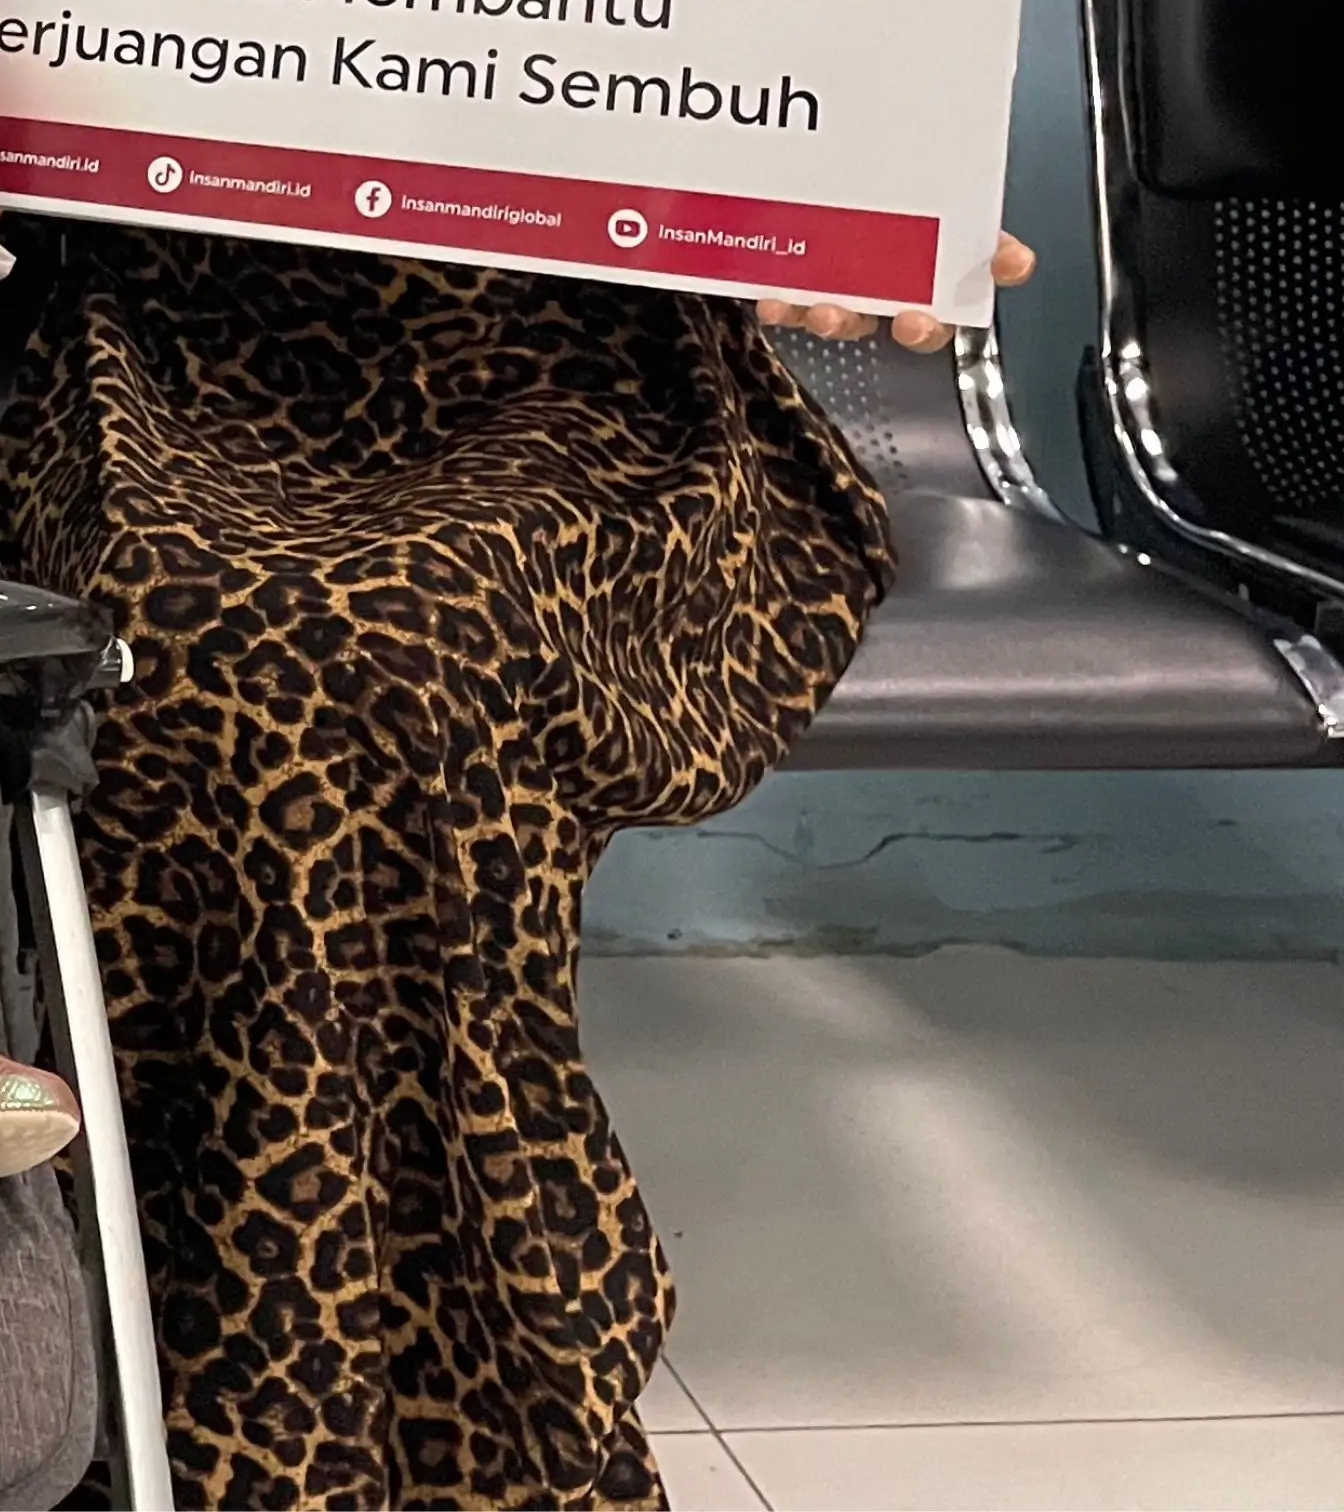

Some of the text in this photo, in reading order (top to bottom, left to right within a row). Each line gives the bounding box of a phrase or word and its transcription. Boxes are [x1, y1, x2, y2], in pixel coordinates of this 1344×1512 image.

[332, 36, 498, 100] Kami
[519, 54, 819, 131] Sembuh
[658, 223, 806, 256] InsanMandiri_id
